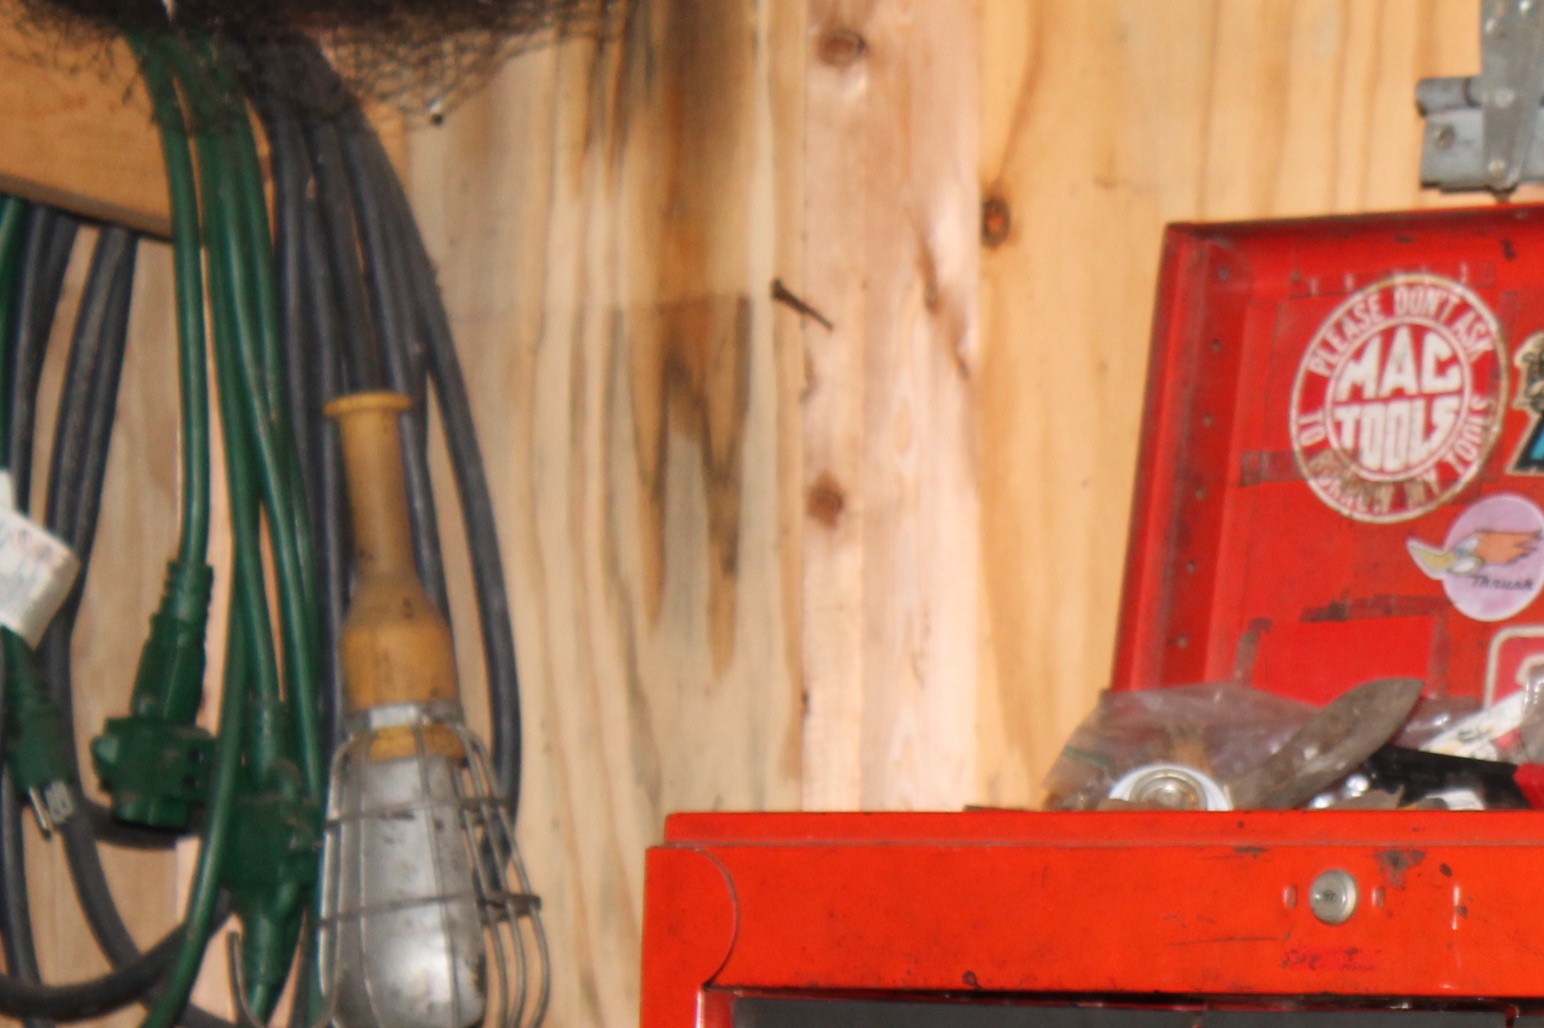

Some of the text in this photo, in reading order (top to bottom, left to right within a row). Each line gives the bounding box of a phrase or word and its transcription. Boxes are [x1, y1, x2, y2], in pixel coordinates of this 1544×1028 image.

[1308, 284, 1494, 377] PLEASE DON'T ASK
[1335, 325, 1463, 401] MAC
[1334, 397, 1461, 472] TOOLS
